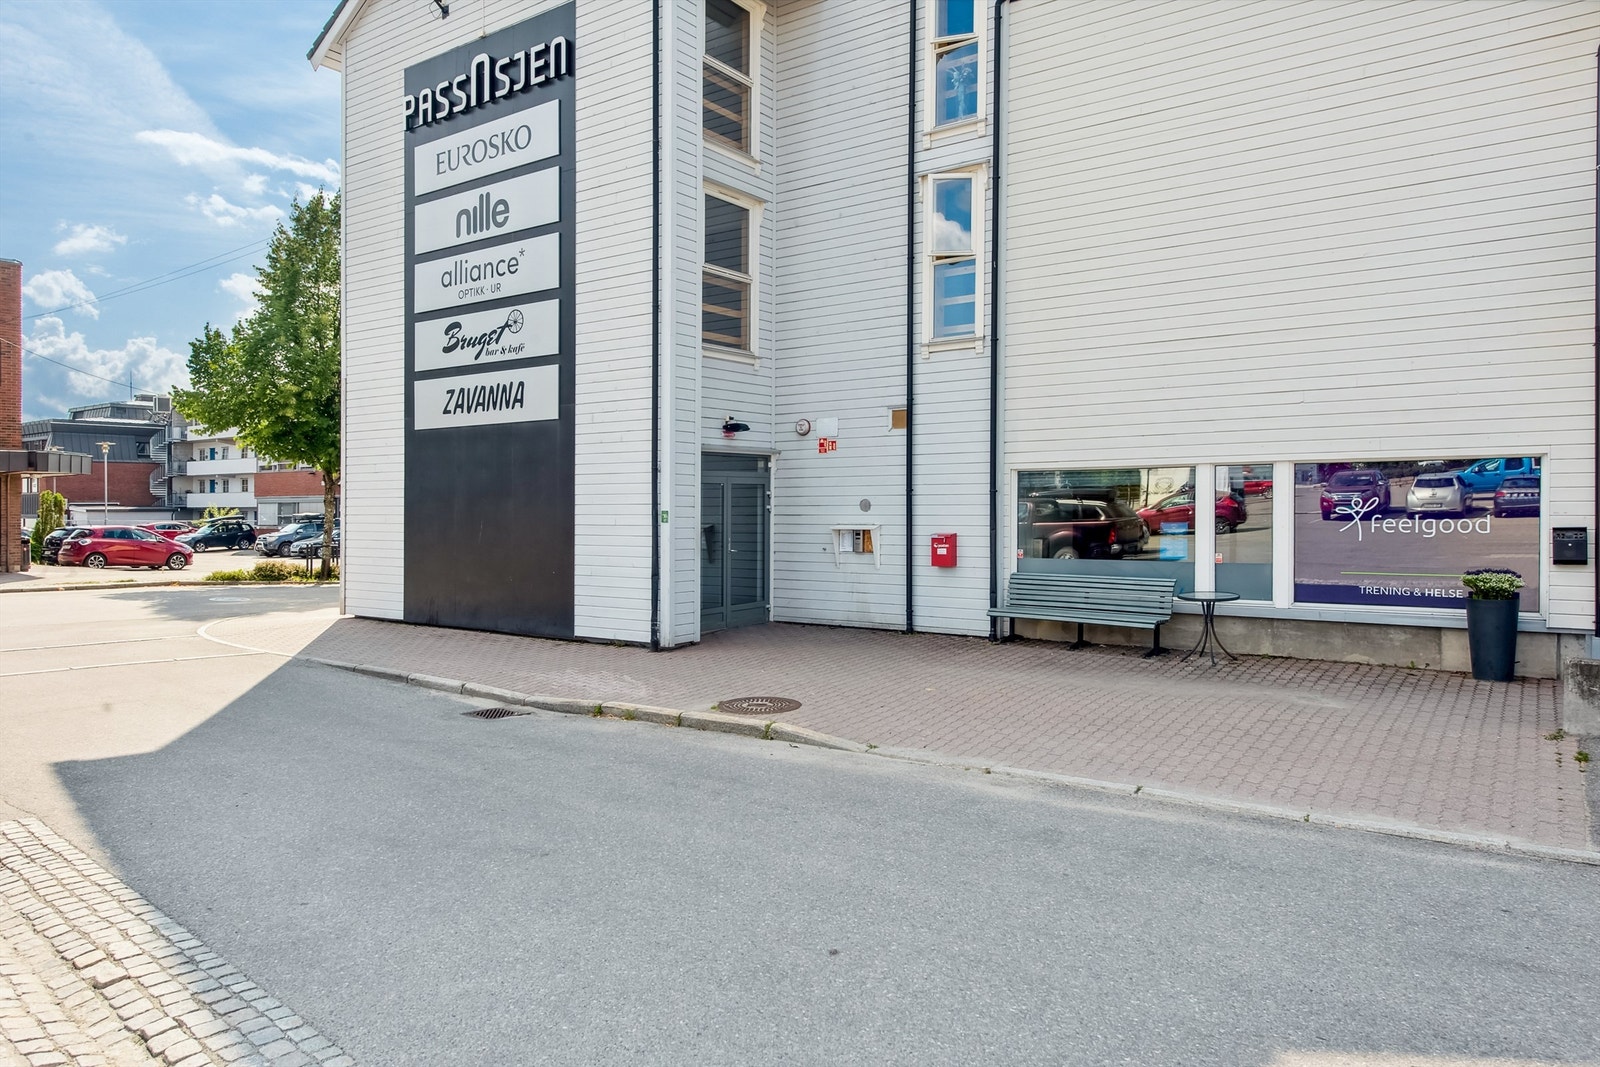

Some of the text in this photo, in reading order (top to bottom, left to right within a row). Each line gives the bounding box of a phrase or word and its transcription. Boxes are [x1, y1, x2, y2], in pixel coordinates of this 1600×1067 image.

[436, 124, 532, 176] EUROSKO
[456, 192, 510, 238] nille
[458, 283, 502, 300] OPTIKK UR
[442, 316, 513, 361] Bruget
[442, 380, 525, 415] ZAVANNA
[1371, 514, 1491, 538] feelgood
[1359, 585, 1464, 599] TRENING & HELSE
